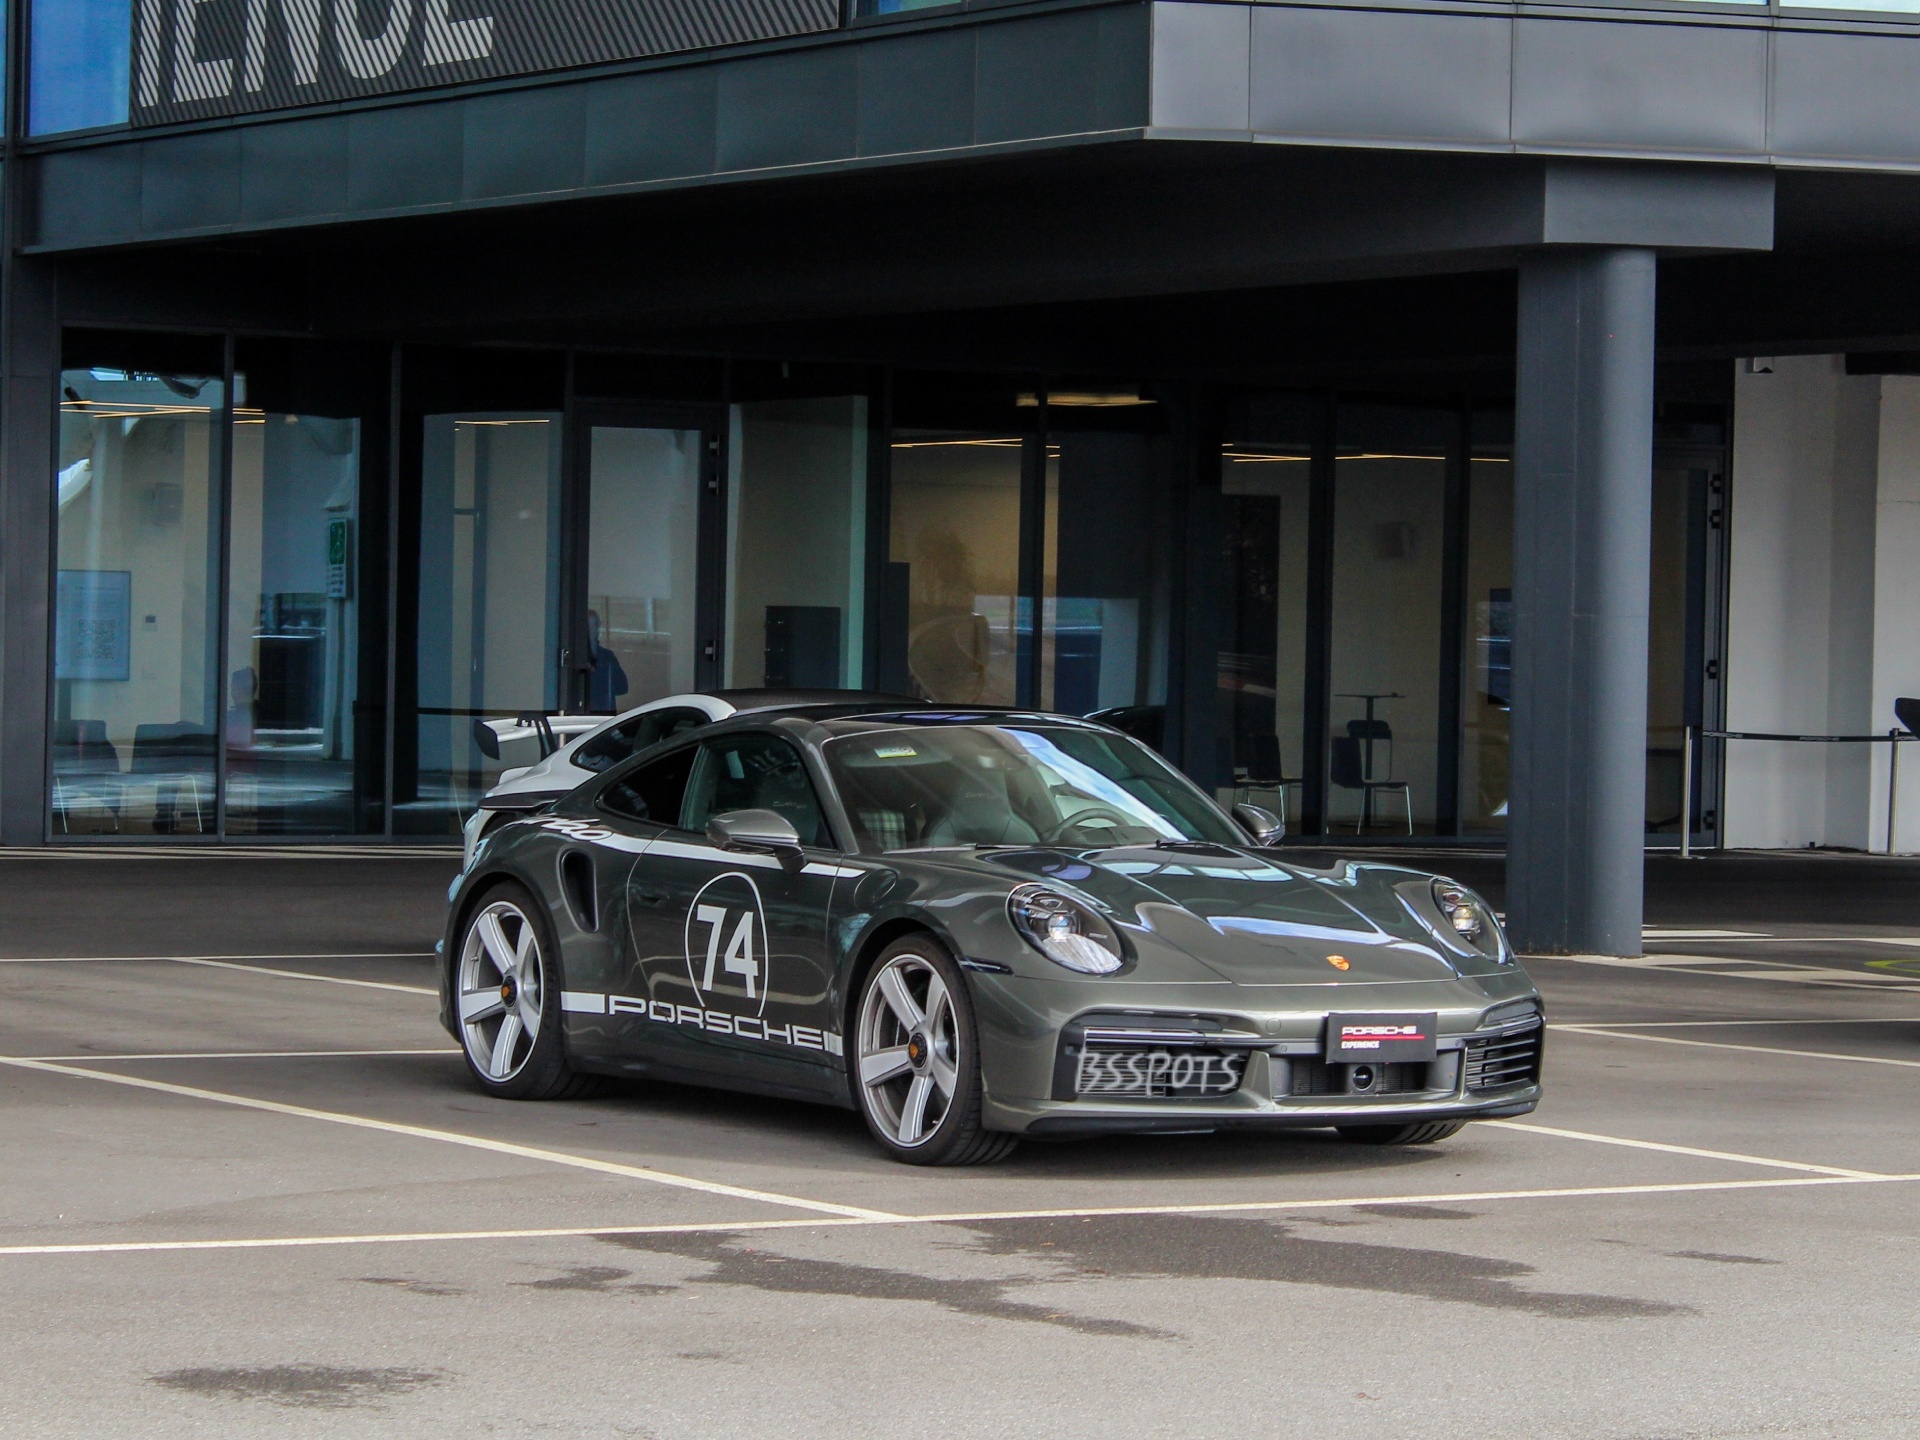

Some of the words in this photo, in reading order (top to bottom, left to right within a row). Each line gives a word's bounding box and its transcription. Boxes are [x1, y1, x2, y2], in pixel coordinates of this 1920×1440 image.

[697, 904, 758, 998] 74
[608, 994, 824, 1050] PORSCHE
[1341, 1025, 1417, 1035] PORSCHE
[1341, 1040, 1380, 1049] EXPERIENCE
